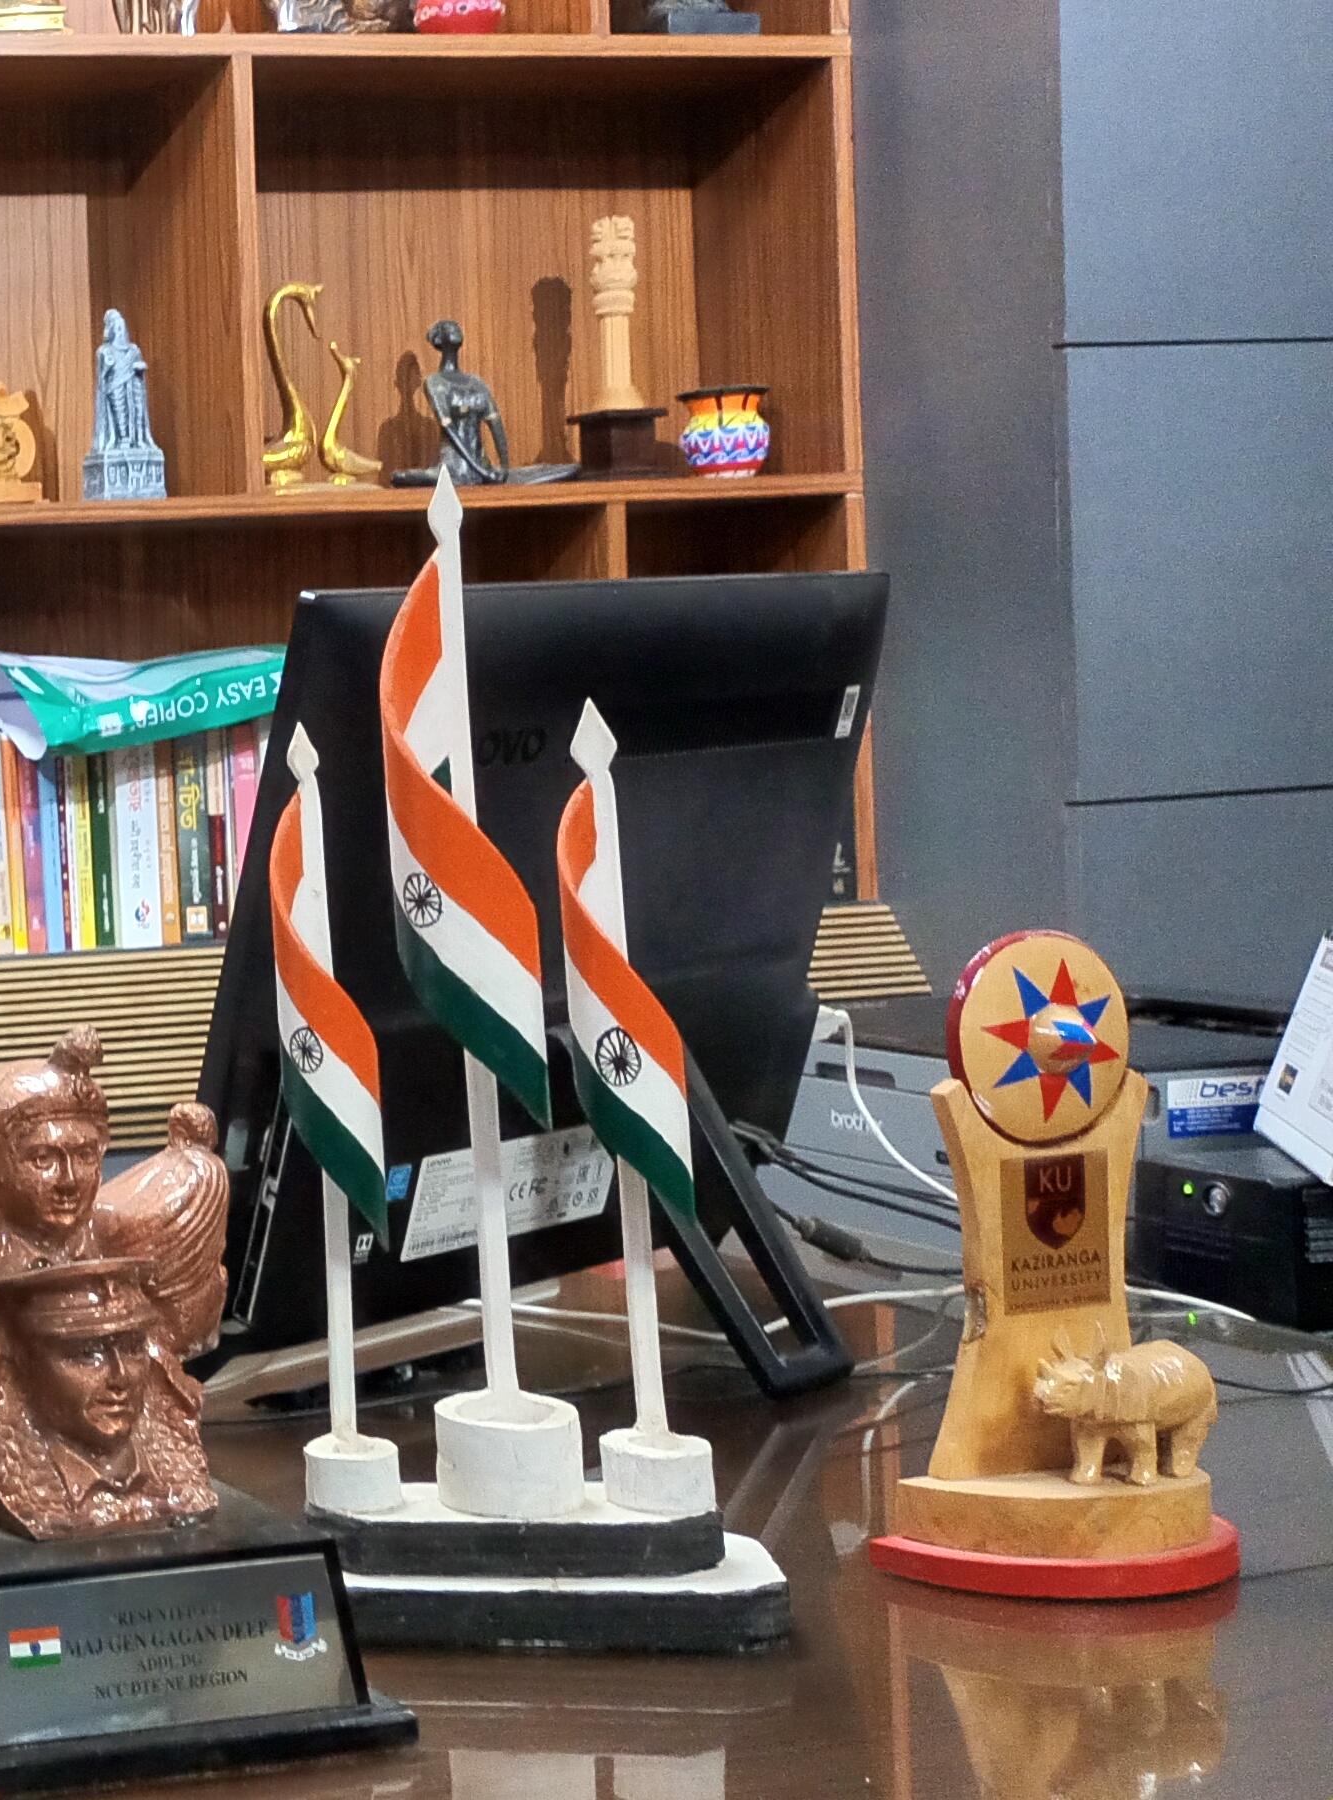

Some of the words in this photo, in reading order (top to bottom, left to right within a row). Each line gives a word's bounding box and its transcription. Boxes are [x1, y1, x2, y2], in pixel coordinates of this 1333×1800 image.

[215, 675, 266, 709] EASY
[830, 1108, 883, 1134] brothr
[1039, 1166, 1072, 1193] KU
[1011, 1250, 1101, 1273] KAZIRANGA
[1011, 1270, 1102, 1291] UNIVERSITY
[64, 1637, 103, 1657] MAJ
[108, 1632, 147, 1655] GEN
[150, 1625, 217, 1649] GAGAN
[222, 1619, 268, 1642] DEEP
[95, 1681, 128, 1700] NCC
[188, 1669, 248, 1691] REGION
